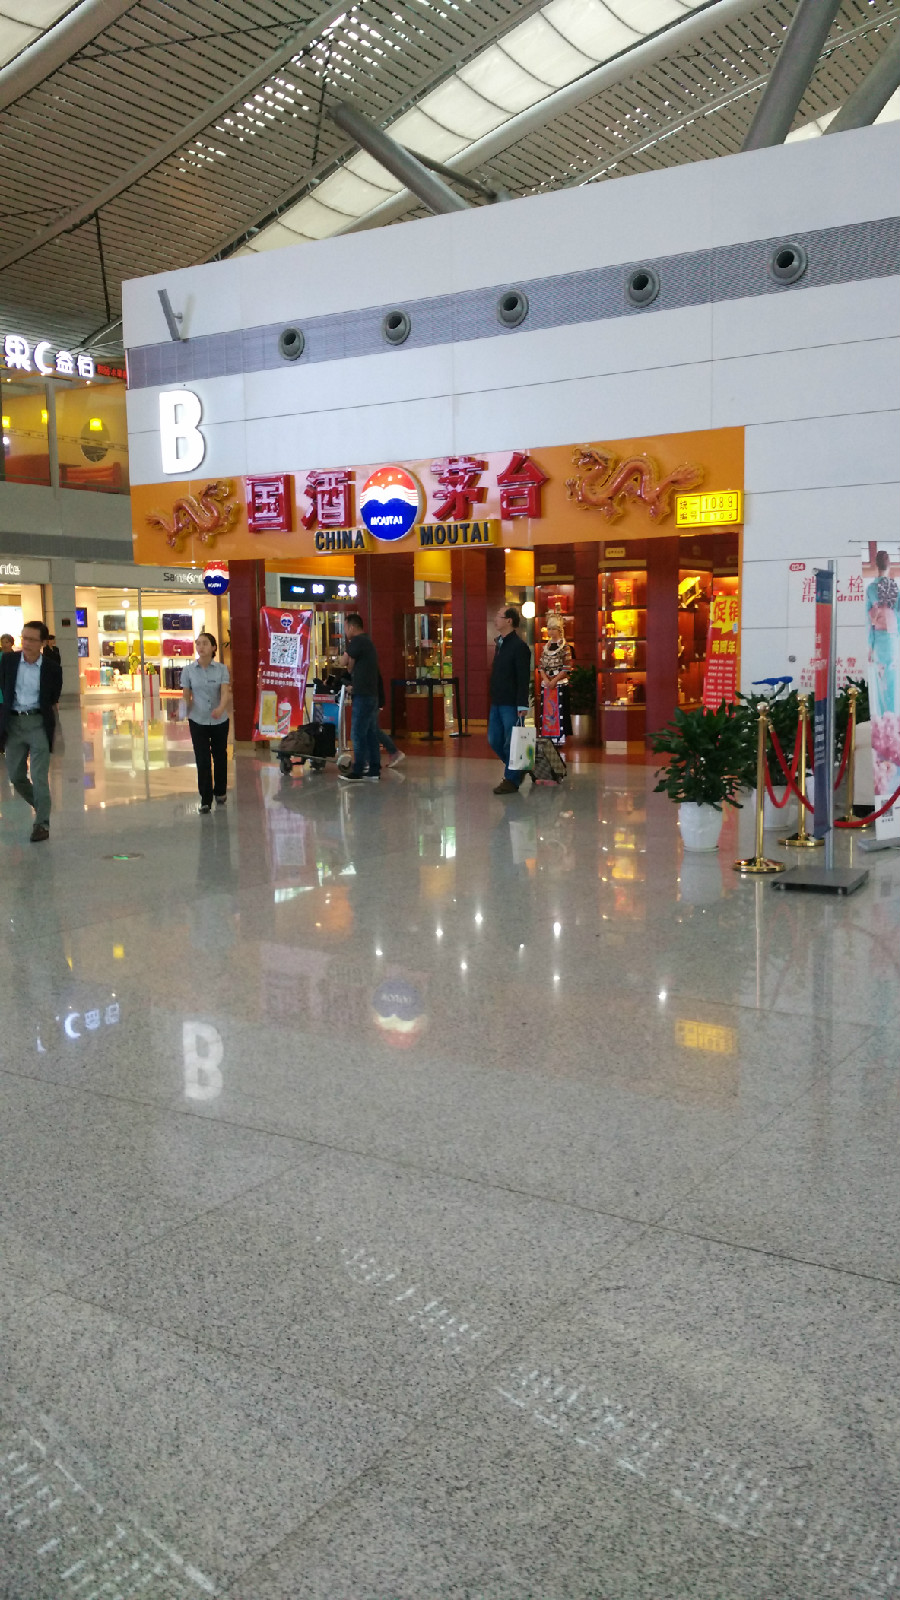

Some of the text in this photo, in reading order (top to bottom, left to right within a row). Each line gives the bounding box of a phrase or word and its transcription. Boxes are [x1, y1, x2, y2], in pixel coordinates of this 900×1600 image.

[159, 389, 206, 475] B
[246, 452, 548, 532] 国酒 茅台
[315, 521, 489, 550] CHINA MOUTAI
[370, 515, 403, 526] MOUTAI
